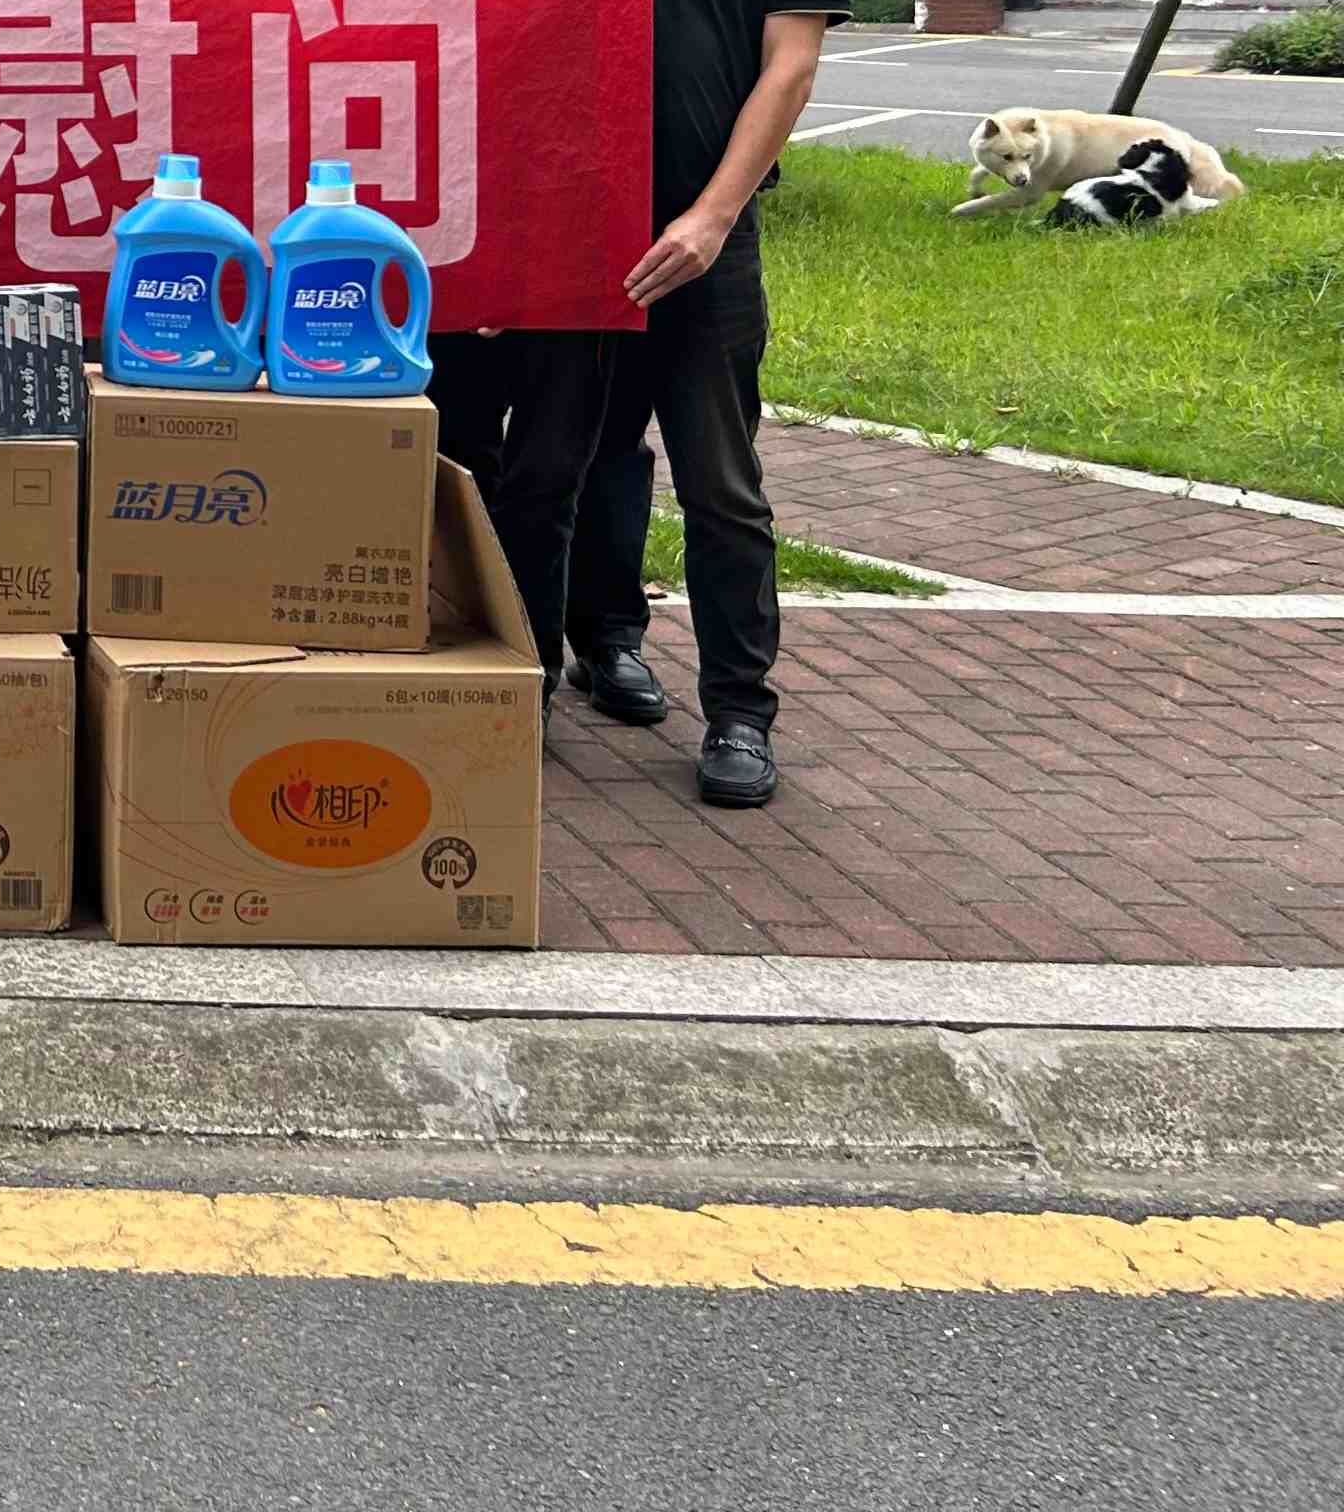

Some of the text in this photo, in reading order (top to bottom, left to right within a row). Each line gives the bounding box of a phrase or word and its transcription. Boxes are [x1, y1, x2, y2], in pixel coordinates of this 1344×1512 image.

[133, 274, 206, 302] 蓝月亮
[292, 281, 366, 309] 蓝月亮
[157, 420, 233, 436] 10000721
[106, 469, 267, 526] 蓝月亮
[324, 564, 413, 585] 亮白增艳
[271, 783, 388, 830] 心相印
[433, 859, 467, 876] 100%
